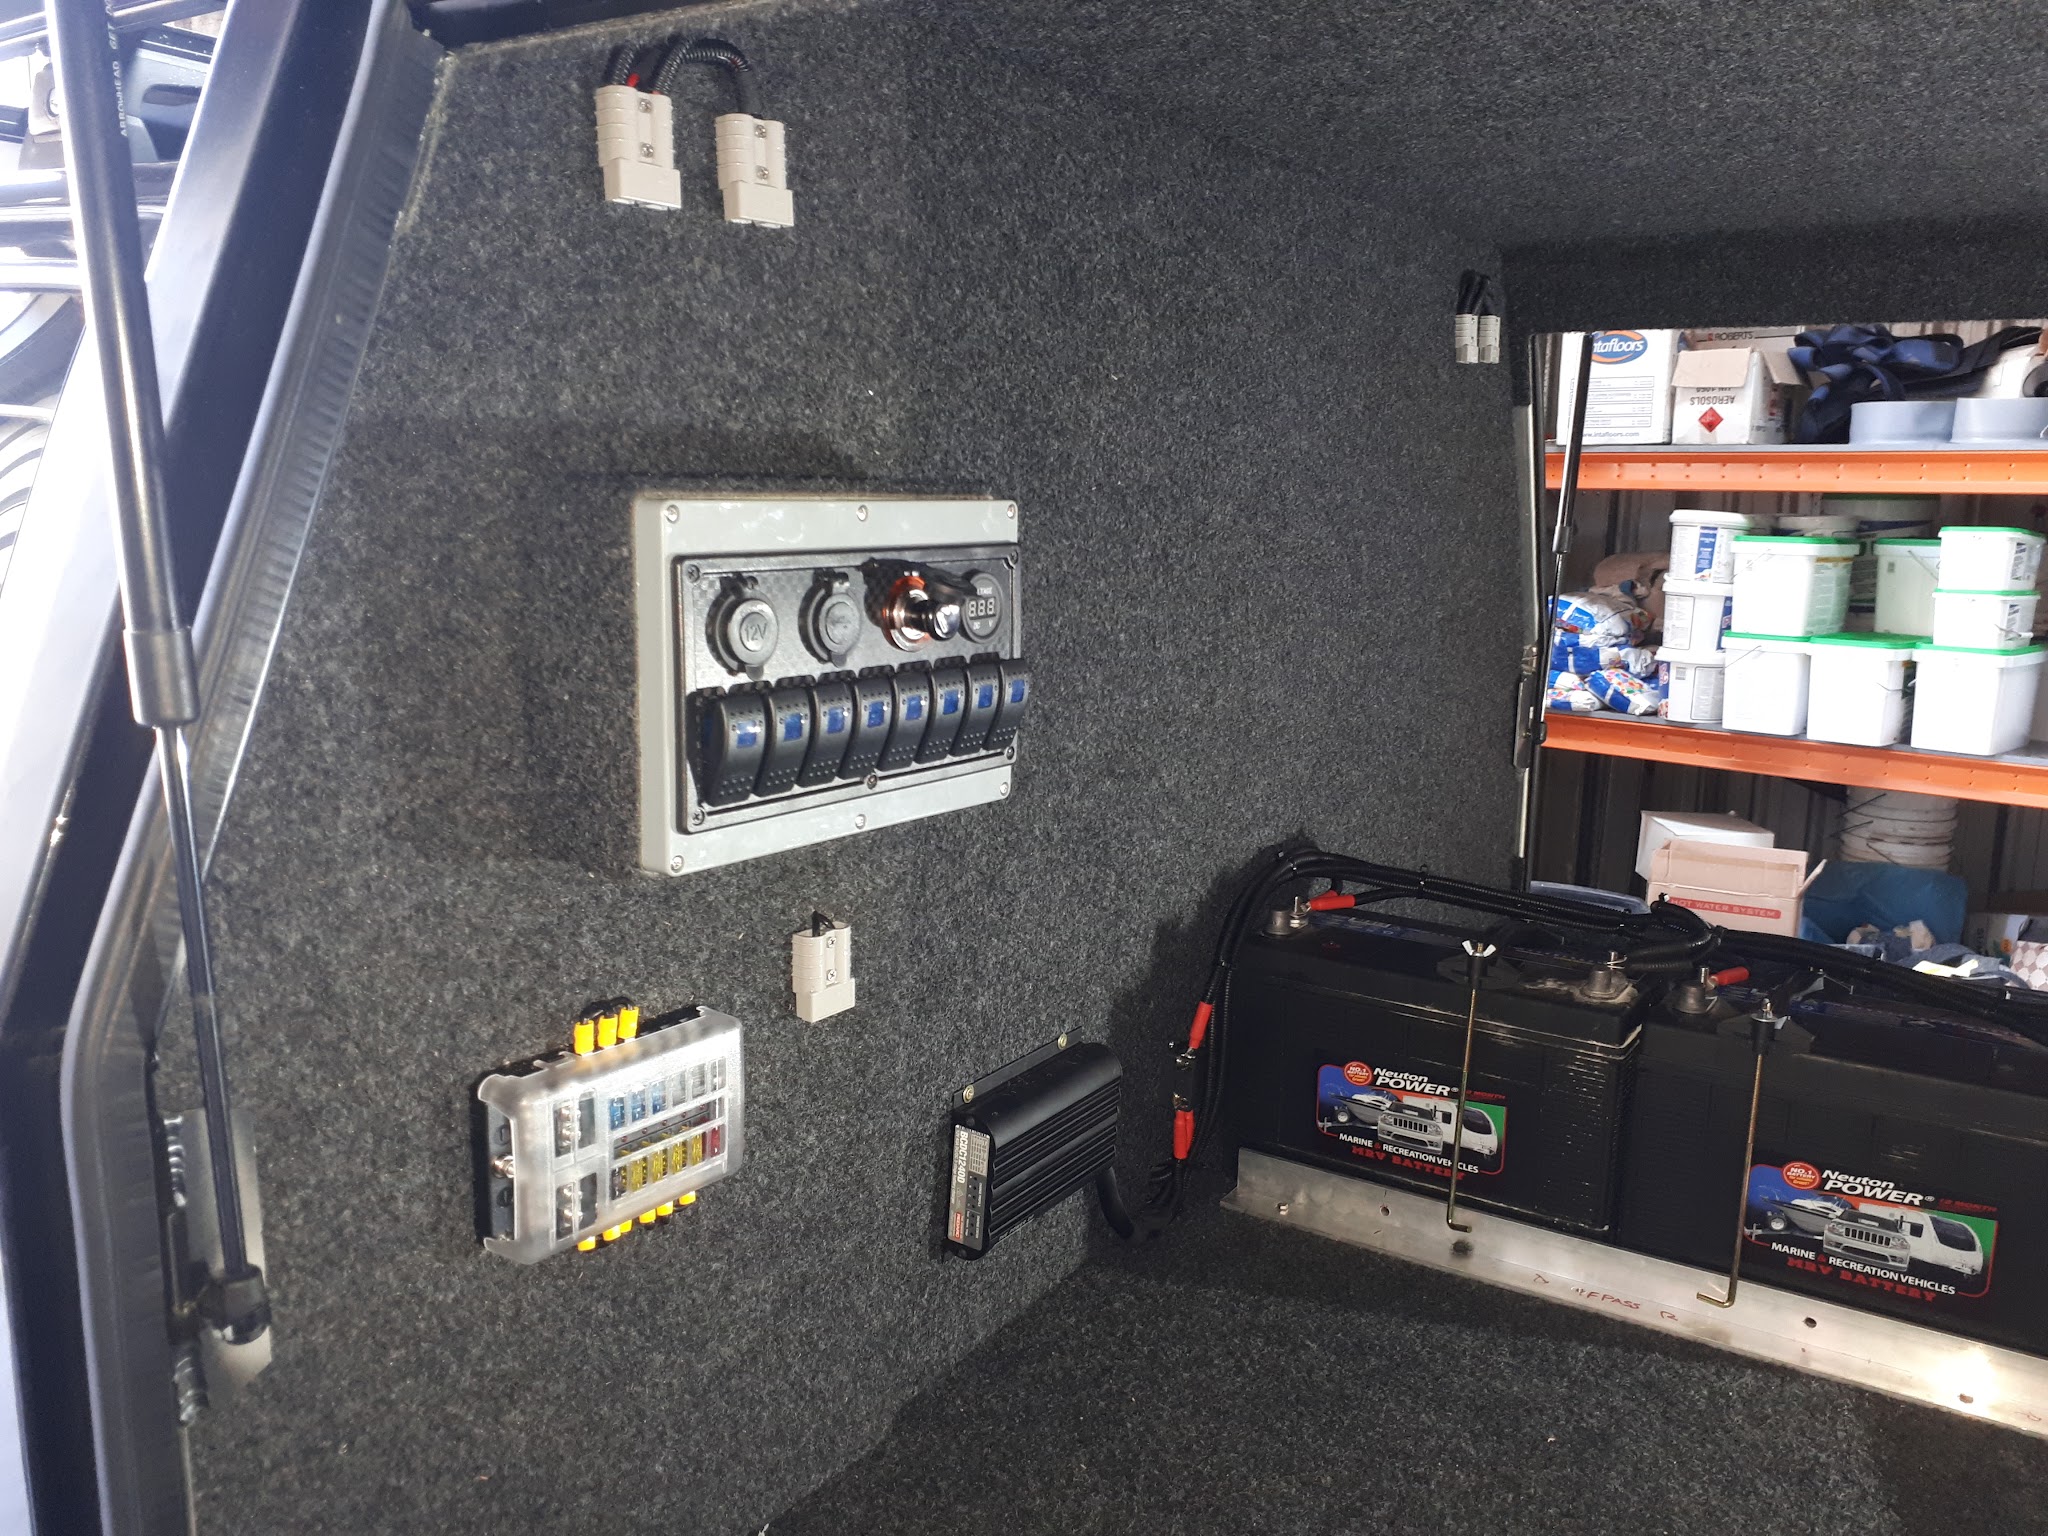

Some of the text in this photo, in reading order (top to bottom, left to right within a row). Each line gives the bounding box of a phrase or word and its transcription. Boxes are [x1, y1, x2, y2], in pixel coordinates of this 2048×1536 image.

[112, 61, 128, 137] ARROWHEAD
[1592, 338, 1645, 353] ntafloors
[1714, 331, 1753, 341] ROBERTS
[1689, 395, 1736, 405] AEROSOLS
[744, 622, 768, 642] 12V
[1670, 899, 1777, 918] HOT WATER SYSTEM
[1374, 1067, 1429, 1083] Neuton
[957, 1130, 969, 1184] BCDC1240D
[1339, 1133, 1374, 1148] MARINE
[1383, 1143, 1437, 1163] RECREATION
[1436, 1157, 1480, 1174] VEHCLES
[1821, 1169, 1895, 1189] Neuton
[1771, 1241, 1816, 1261] MARINE
[1828, 1256, 1899, 1281] RECREATION
[1900, 1274, 1956, 1295] VEHICLES
[1786, 1257, 1937, 1302] MRV BATTERY
